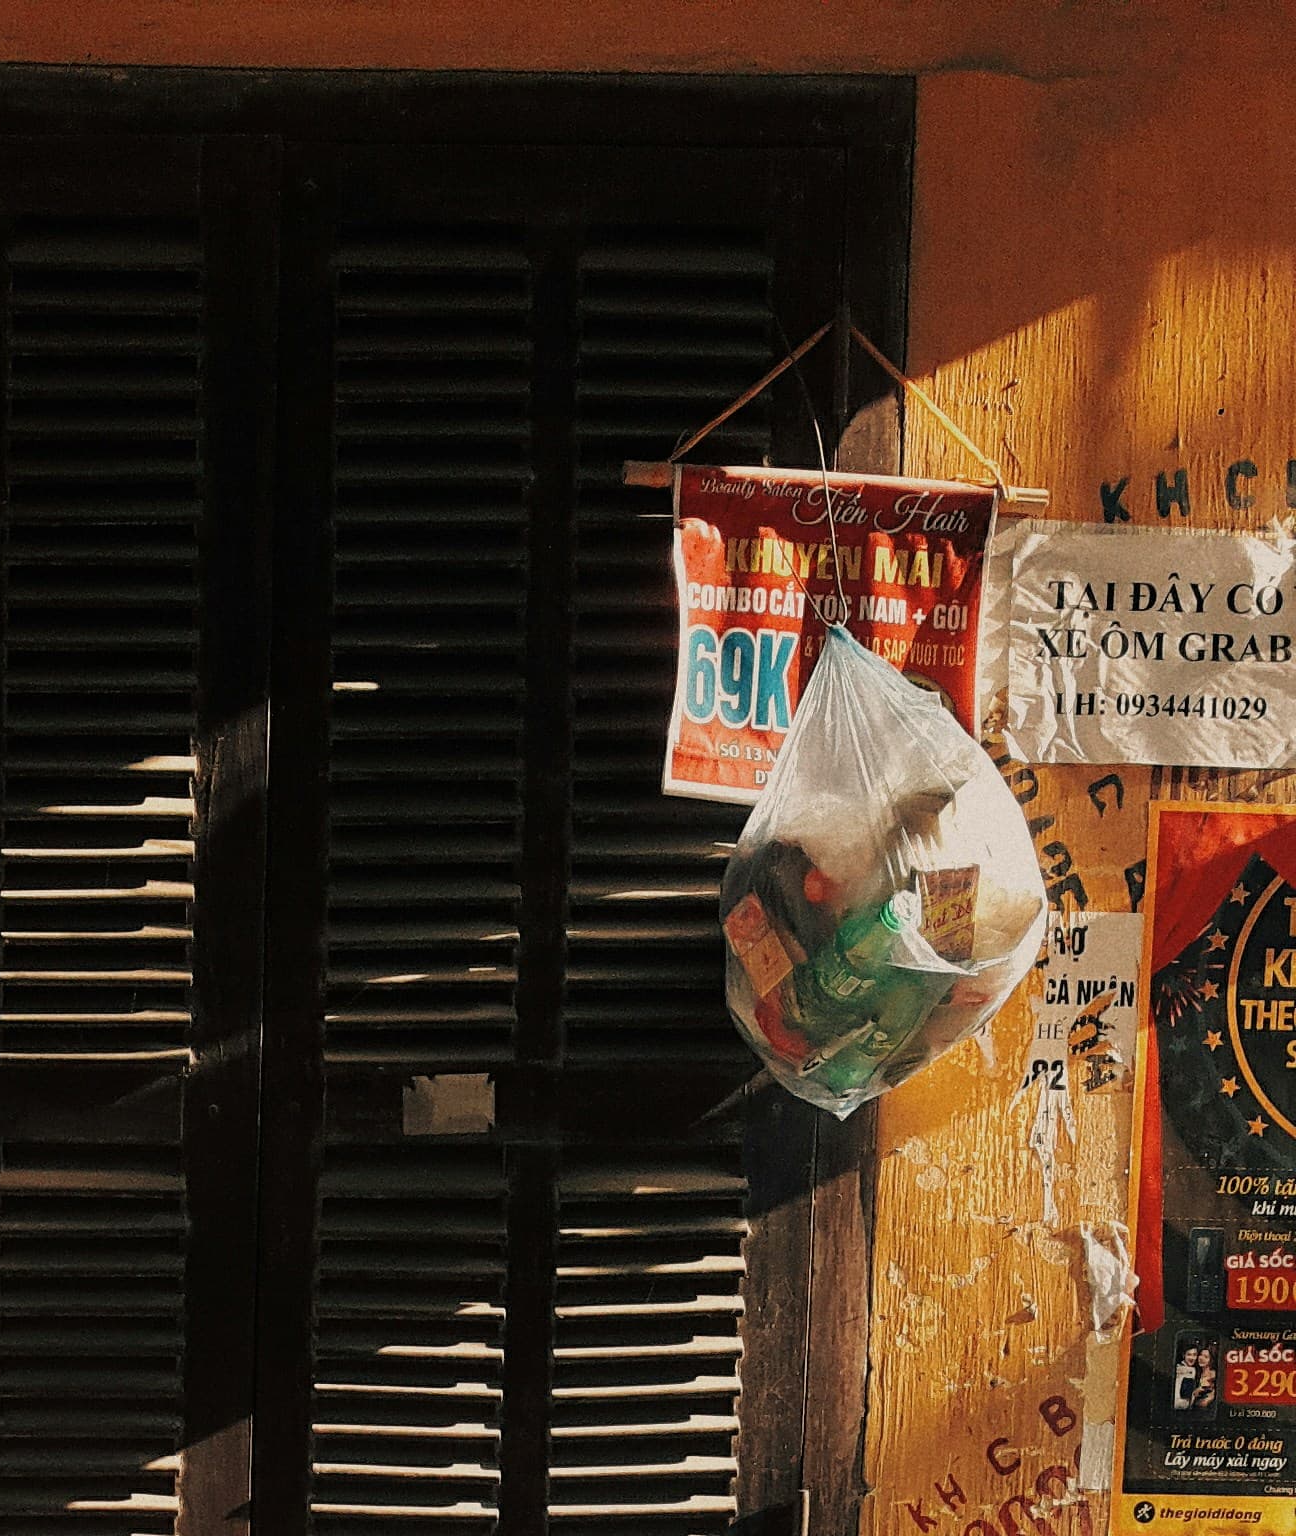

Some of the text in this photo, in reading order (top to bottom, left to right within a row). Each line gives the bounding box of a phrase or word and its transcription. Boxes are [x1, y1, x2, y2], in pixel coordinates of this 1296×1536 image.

[874, 491, 970, 534] Hair
[687, 583, 769, 614] COMBO
[859, 595, 907, 625] NAM
[933, 600, 968, 631] GỘI
[1048, 573, 1283, 619] TẠI ĐÂY CÓ
[1036, 622, 1292, 663] XE ÔM GRAB
[684, 624, 799, 732] 69K
[1116, 693, 1268, 720] 0934441029
[1240, 999, 1296, 1031] THE
[1216, 1175, 1270, 1195] 100%
[1252, 1200, 1277, 1216] khi
[1226, 1246, 1294, 1269] GIÁ SỐC
[1235, 1275, 1296, 1304] 190
[1226, 1343, 1295, 1363] GIÁ SỐC
[1170, 1434, 1192, 1449] Trả
[1248, 1434, 1284, 1454] đồng
[1164, 1450, 1287, 1471] Lấy máy xài ngay
[1160, 1507, 1263, 1523] thegioididong
